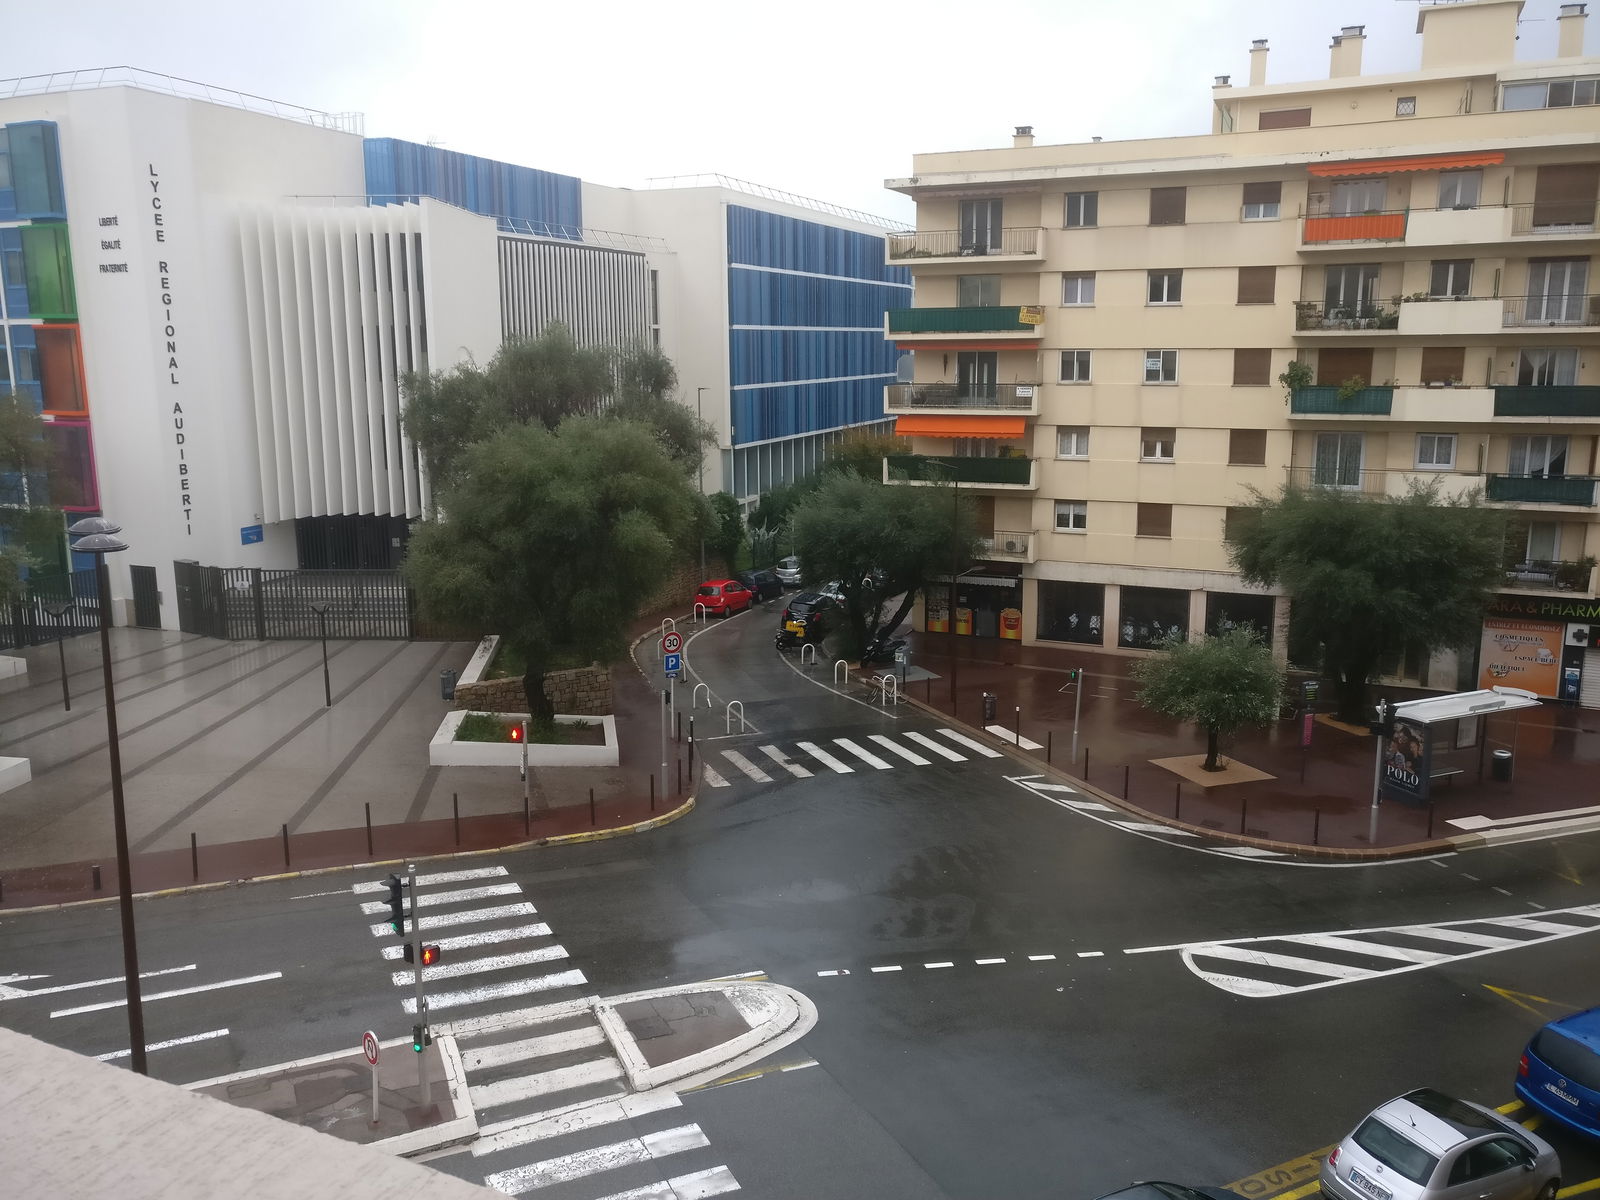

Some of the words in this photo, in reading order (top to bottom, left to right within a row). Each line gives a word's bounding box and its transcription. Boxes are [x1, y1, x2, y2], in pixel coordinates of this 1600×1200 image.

[98, 215, 119, 227] LIBERTÉ
[99, 262, 128, 273] FRATERNITÉ
[149, 164, 165, 242] LYCEE
[159, 261, 179, 385] REGIONAL
[173, 402, 191, 536] AUDIBERTI
[666, 638, 679, 648] 30
[668, 657, 677, 669] P
[1387, 764, 1419, 786] POLO
